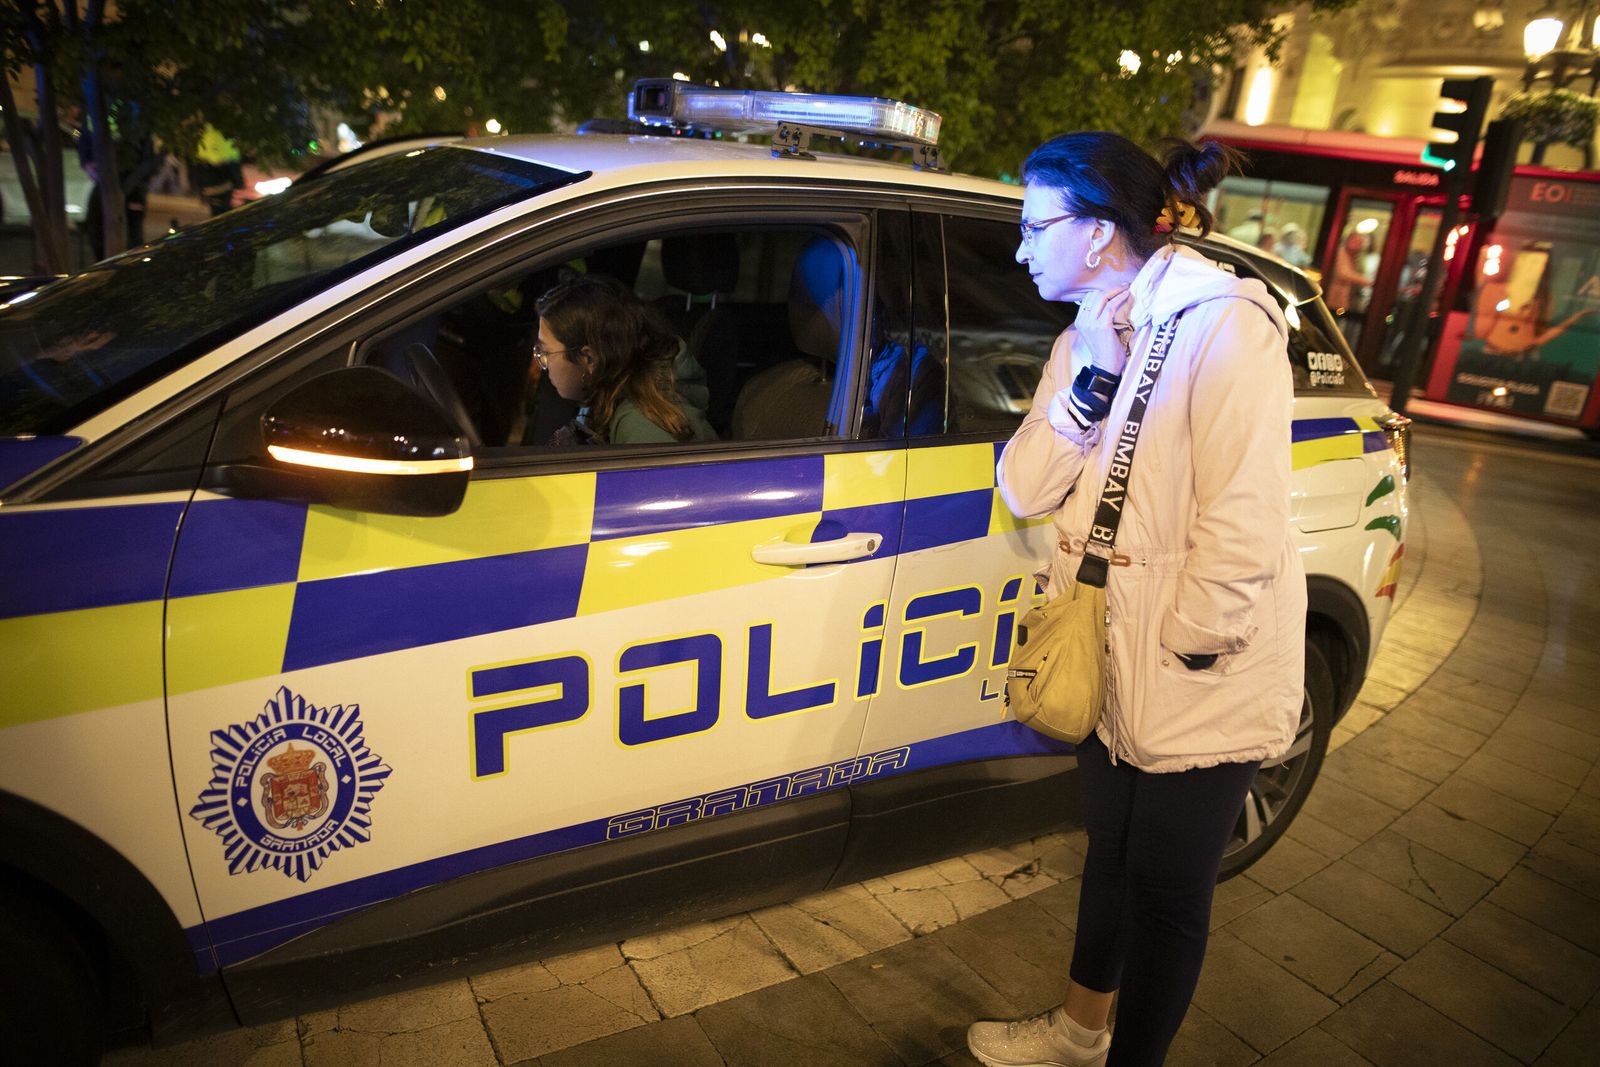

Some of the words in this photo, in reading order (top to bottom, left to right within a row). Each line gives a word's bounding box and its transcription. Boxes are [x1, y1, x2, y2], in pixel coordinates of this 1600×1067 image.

[1101, 420, 1140, 512] BIMBAY
[466, 573, 1046, 781] POLICI
[235, 728, 287, 787] POLICIA
[302, 726, 348, 768] LOCAL
[606, 746, 910, 840] GRANADA
[260, 818, 339, 851] GRANADA
